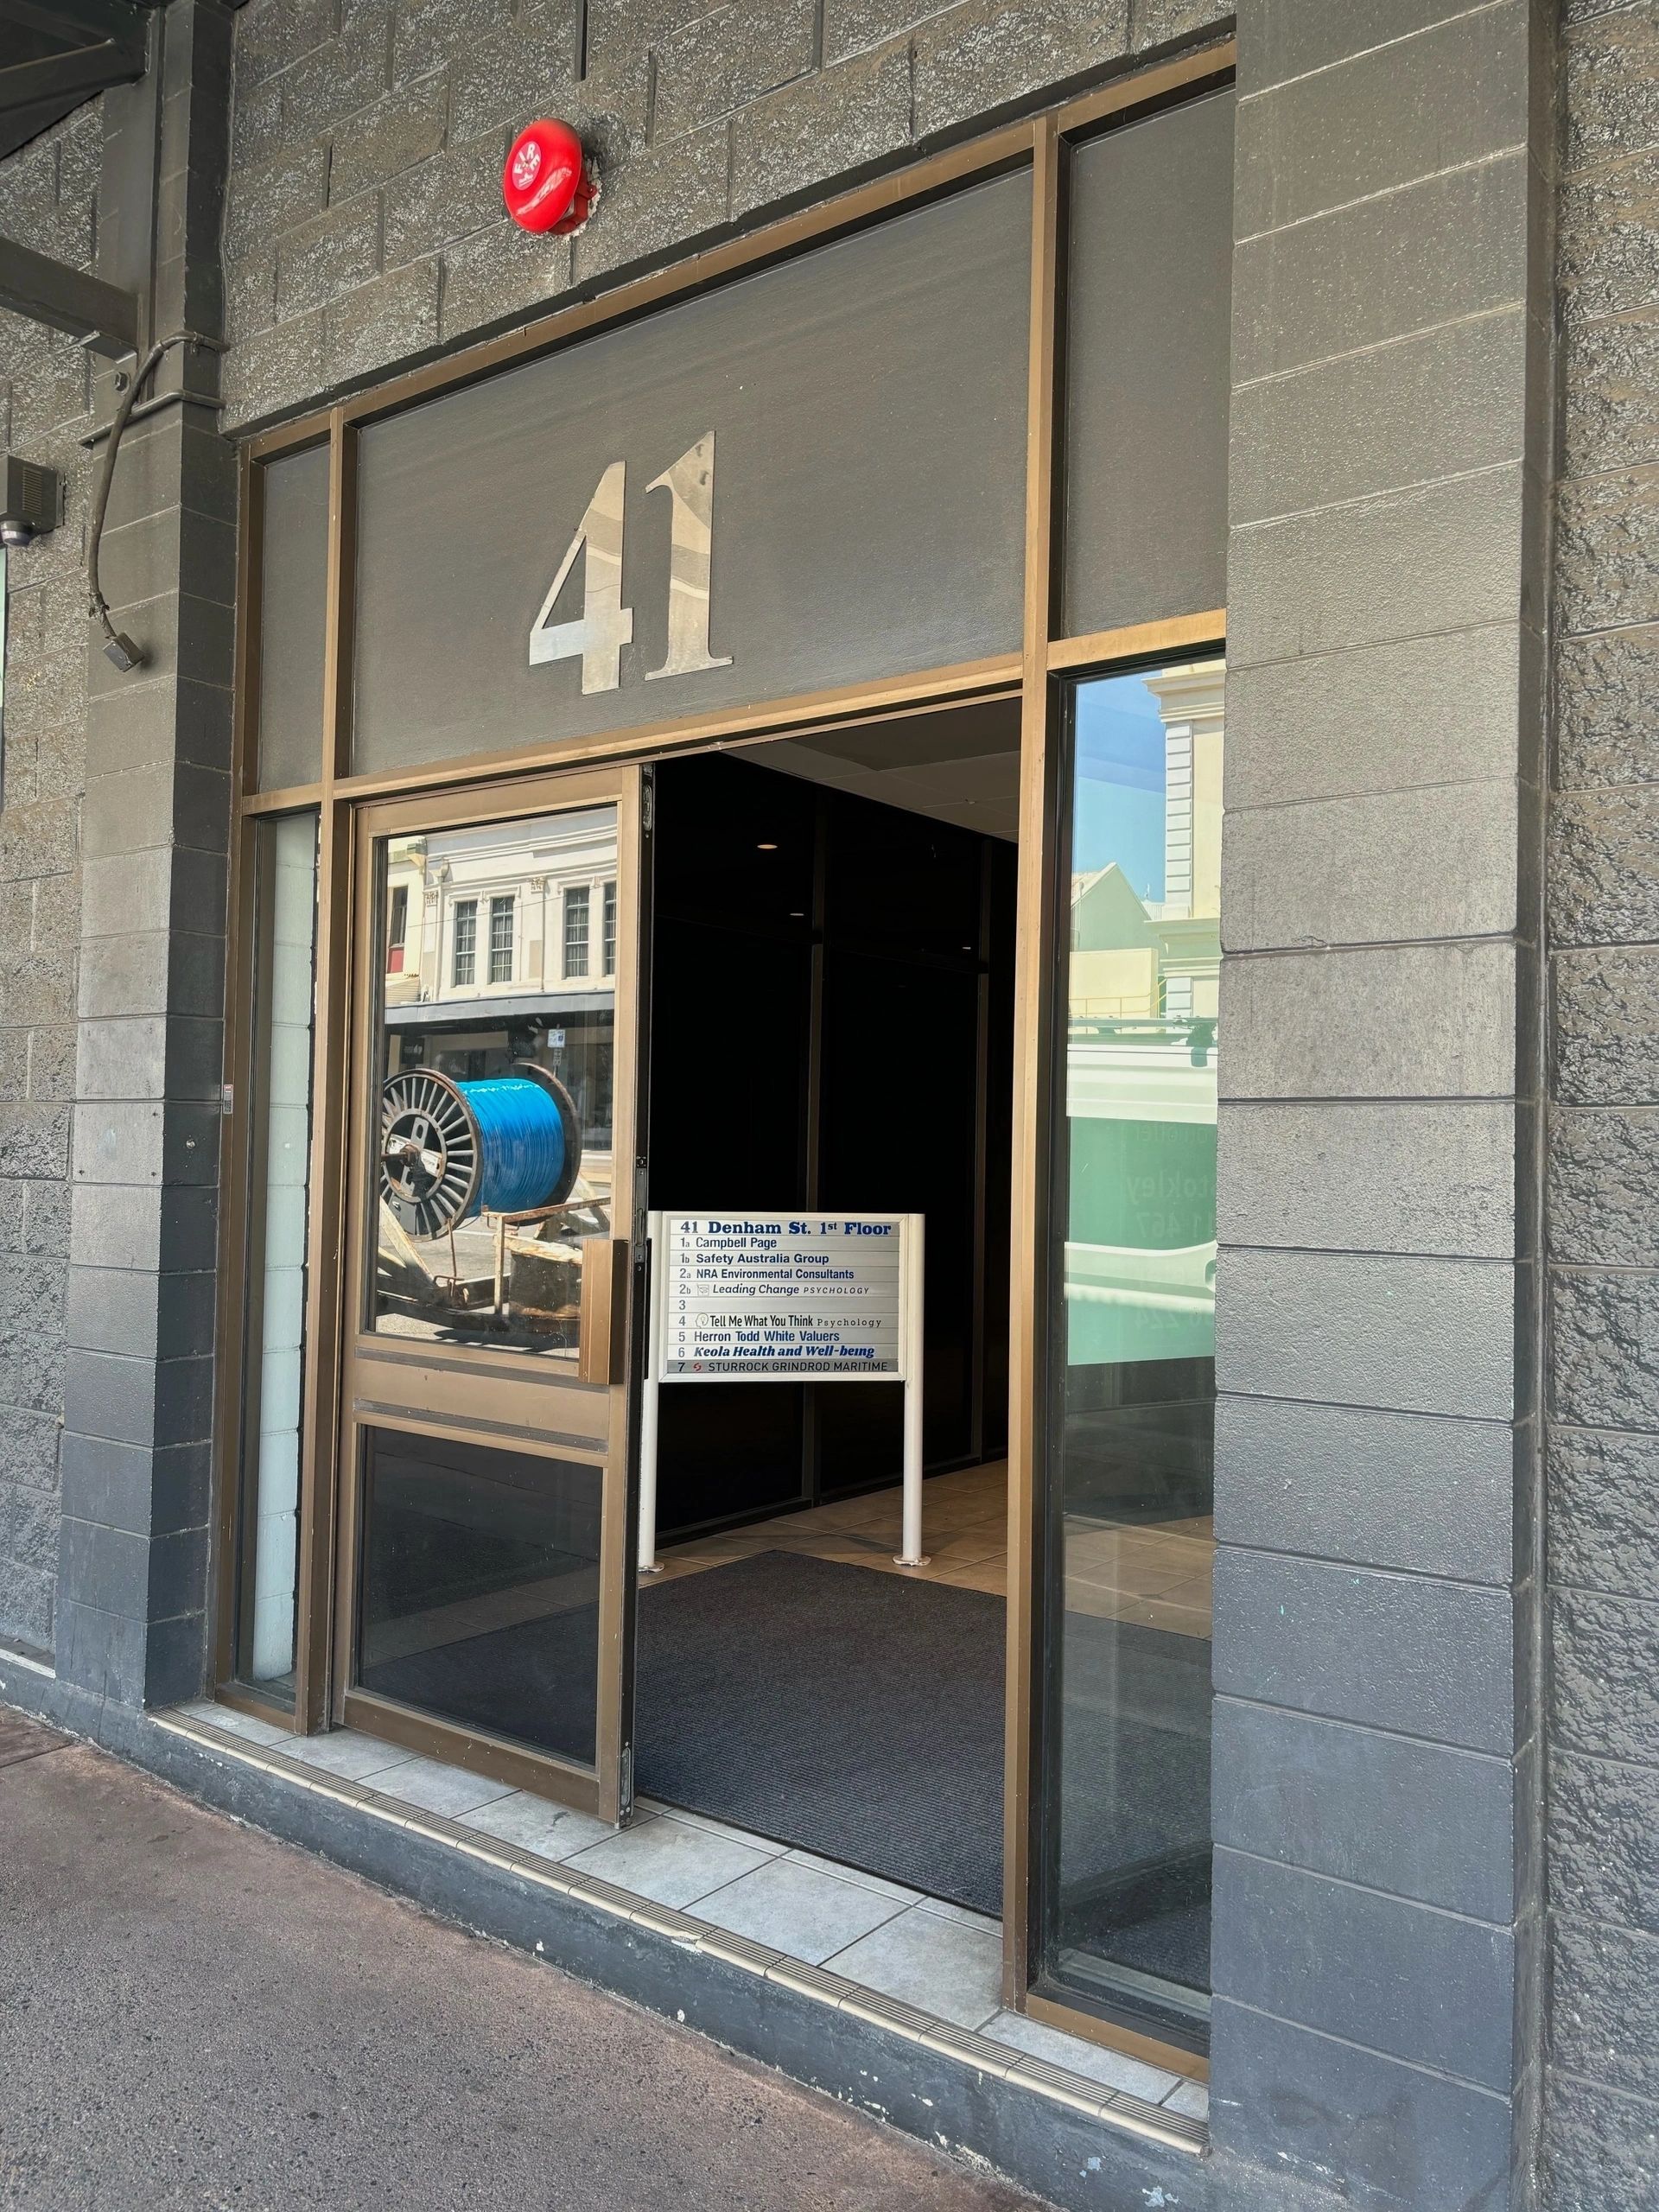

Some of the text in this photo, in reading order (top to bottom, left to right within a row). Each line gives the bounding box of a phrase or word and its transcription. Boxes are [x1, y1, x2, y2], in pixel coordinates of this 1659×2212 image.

[513, 143, 541, 175] FIRE
[529, 429, 734, 696] 41
[680, 1221, 698, 1234] 41
[709, 1221, 781, 1234] Denham
[788, 1221, 811, 1235] St.
[844, 1222, 892, 1235] Floor
[680, 1236, 777, 1249] 1a Campbell Page
[680, 1254, 829, 1265] 1b Safety Australia Group
[679, 1268, 855, 1280] 2a NRA Environmental Consultants
[679, 1284, 869, 1295] 2b Leading Change PSYCHOLOGY
[678, 1300, 686, 1310] 3
[678, 1315, 881, 1328] 4 Tell Me What You Think Psychology
[678, 1331, 840, 1342] 5 Herron Todd White Valuers
[678, 1345, 874, 1358] 6 Keola Health and Well-being
[677, 1362, 887, 1372] 7 STURROCK GRINDROD MARITIME
